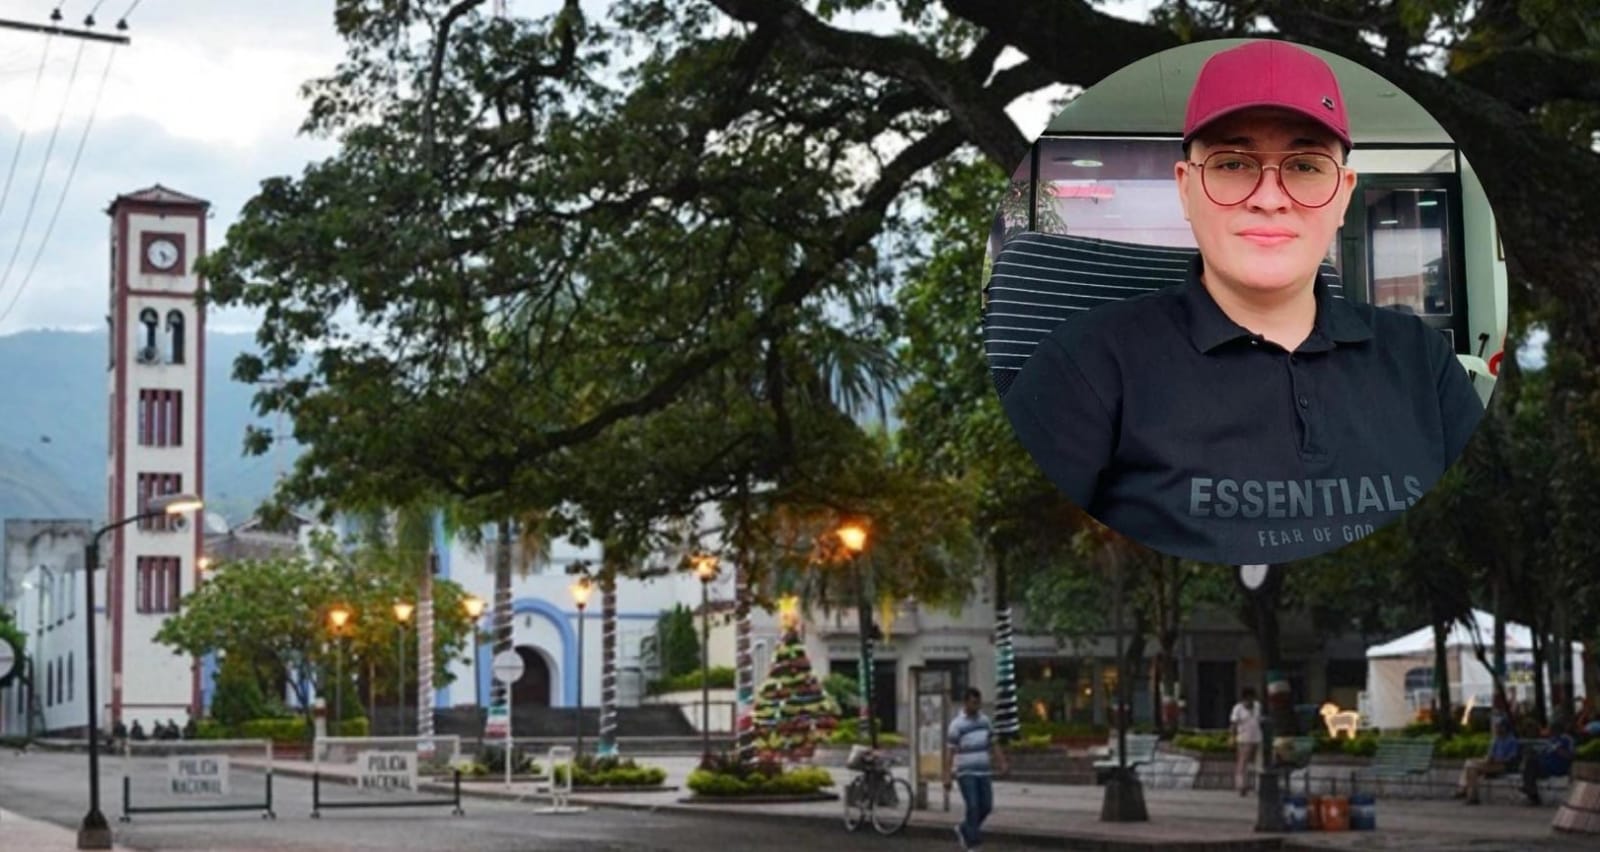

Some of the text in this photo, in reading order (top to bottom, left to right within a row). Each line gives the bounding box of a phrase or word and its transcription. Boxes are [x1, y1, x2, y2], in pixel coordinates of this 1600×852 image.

[1189, 475, 1424, 519] ESSENTIALS
[1257, 530, 1304, 548] FEAR
[1313, 527, 1333, 543] OF
